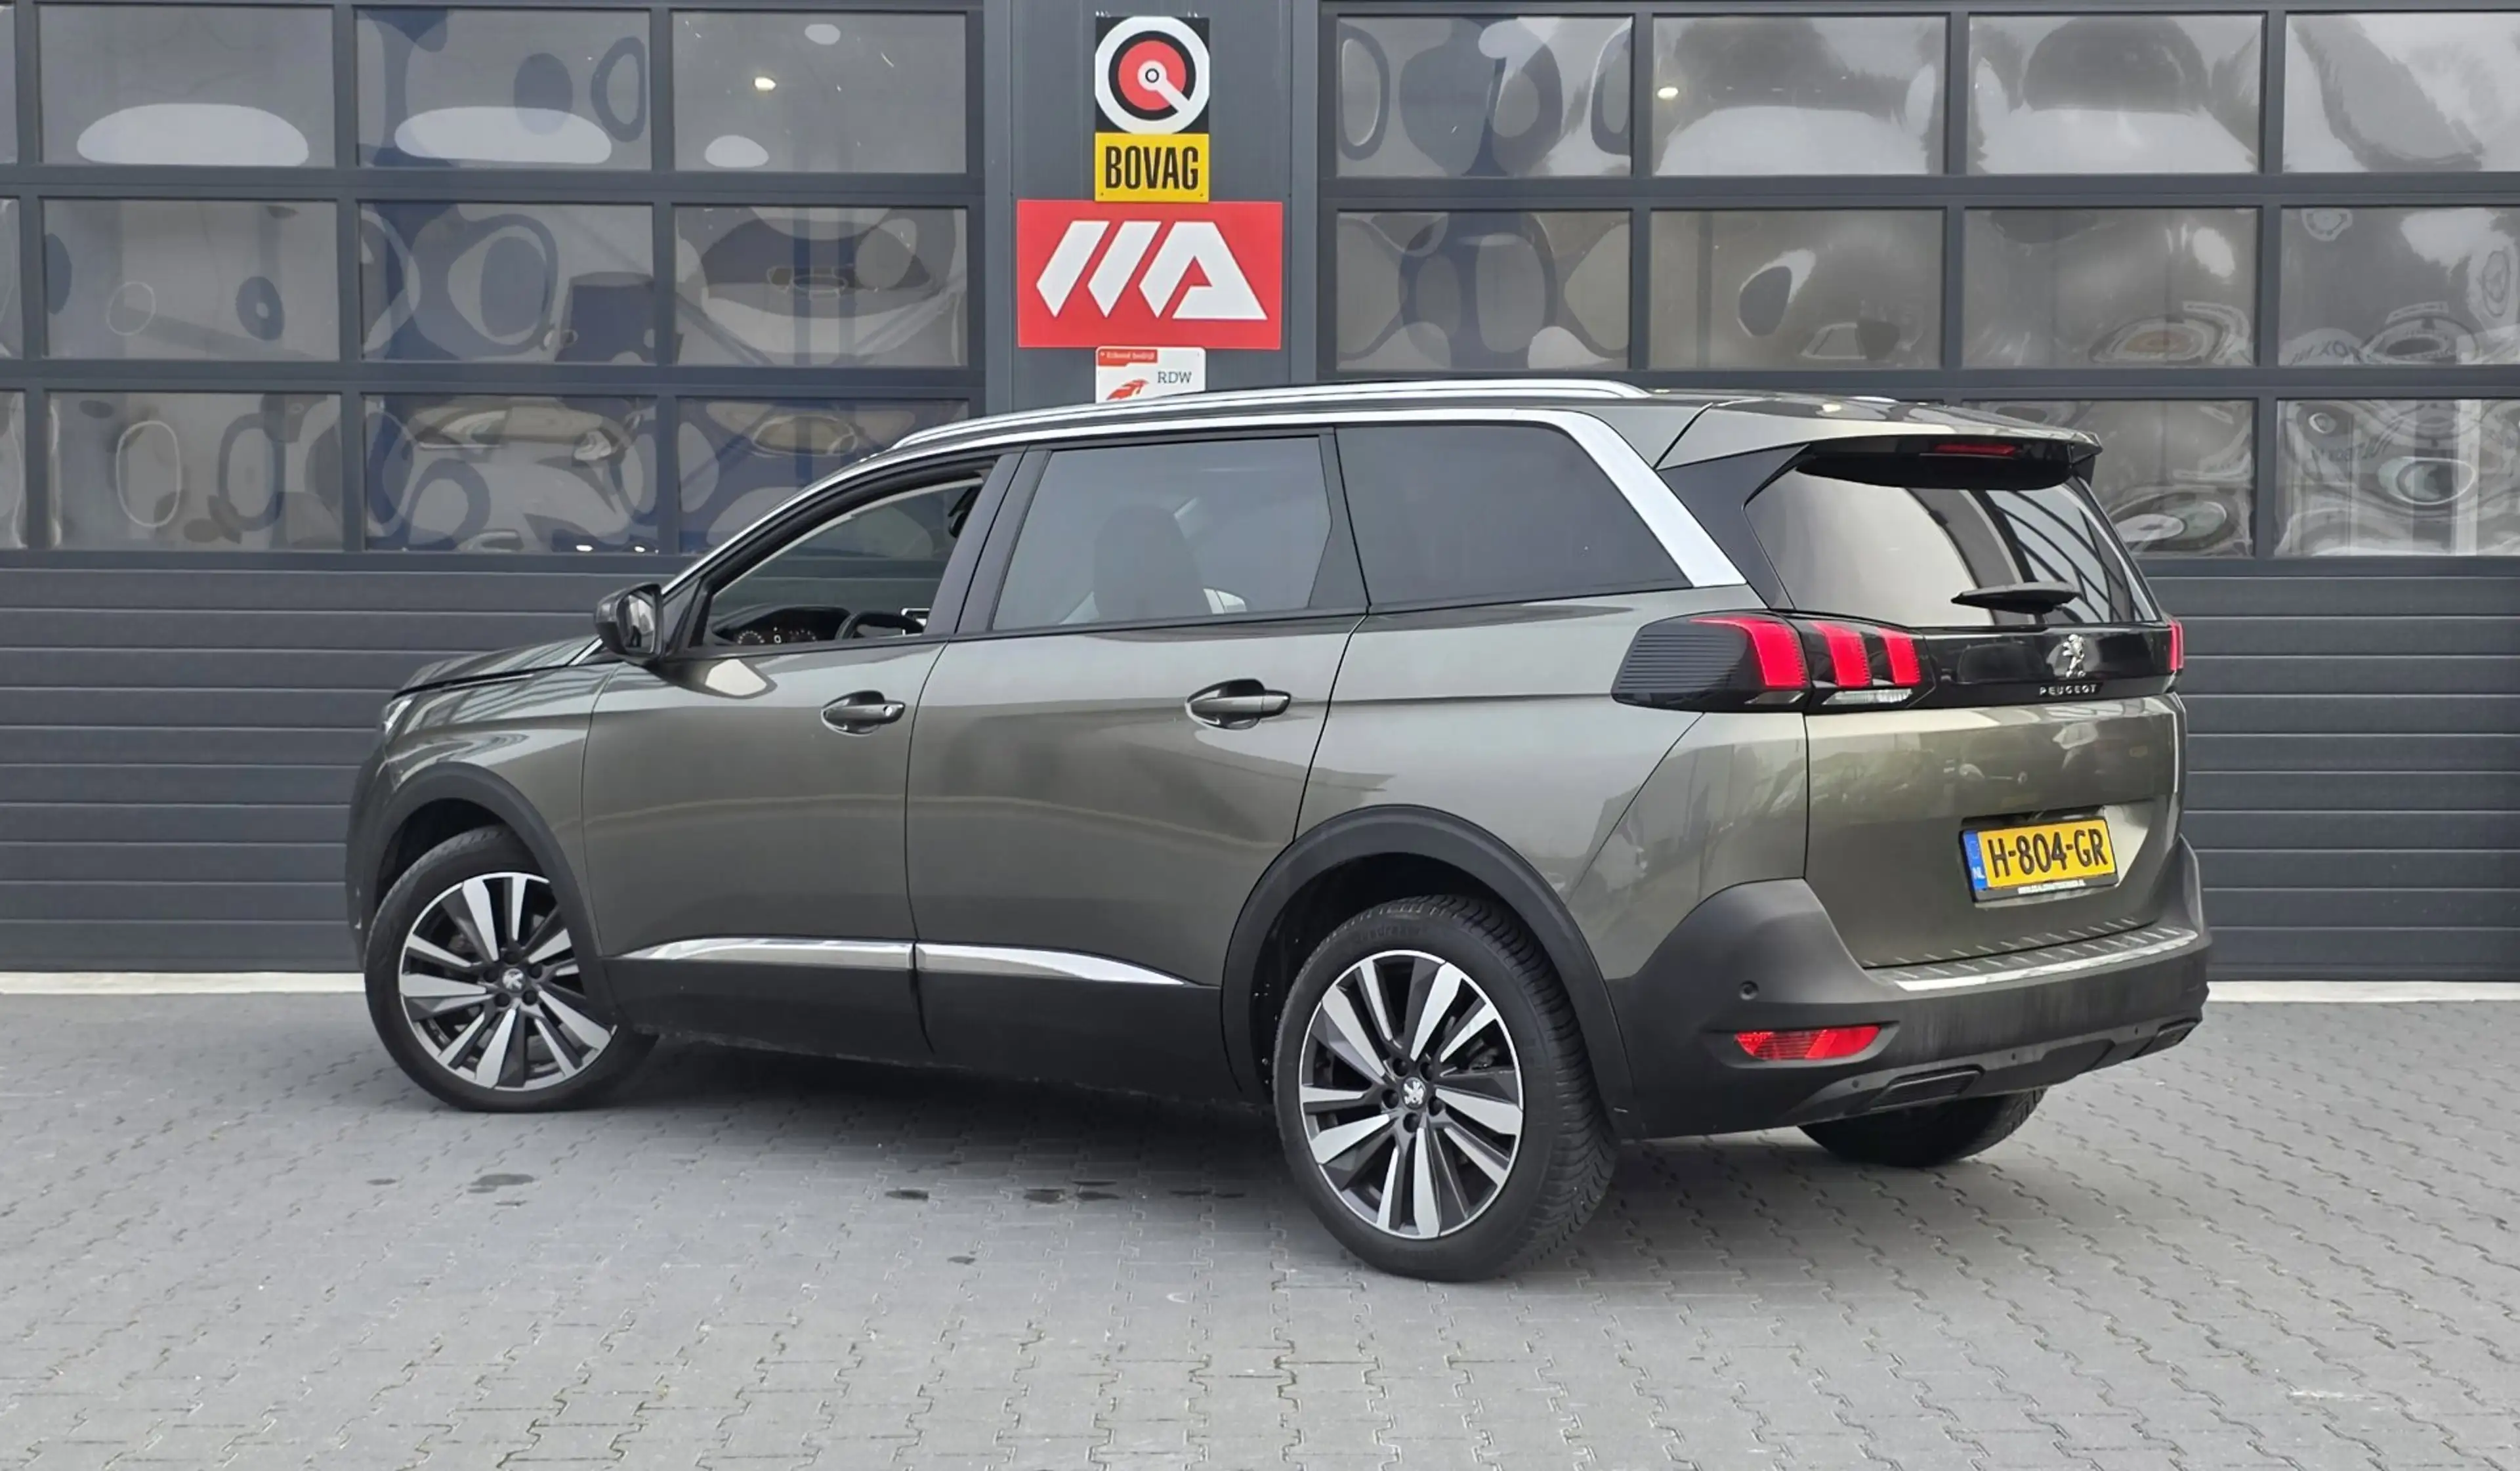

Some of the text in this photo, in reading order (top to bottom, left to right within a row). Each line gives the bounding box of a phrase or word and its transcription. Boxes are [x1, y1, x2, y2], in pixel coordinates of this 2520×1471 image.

[1105, 146, 1199, 190] BOVAG
[1157, 371, 1192, 384] RDW
[2039, 683, 2097, 696] PEUGEOT
[1988, 828, 2109, 878] H-804-GR
[1972, 866, 1986, 880] NL
